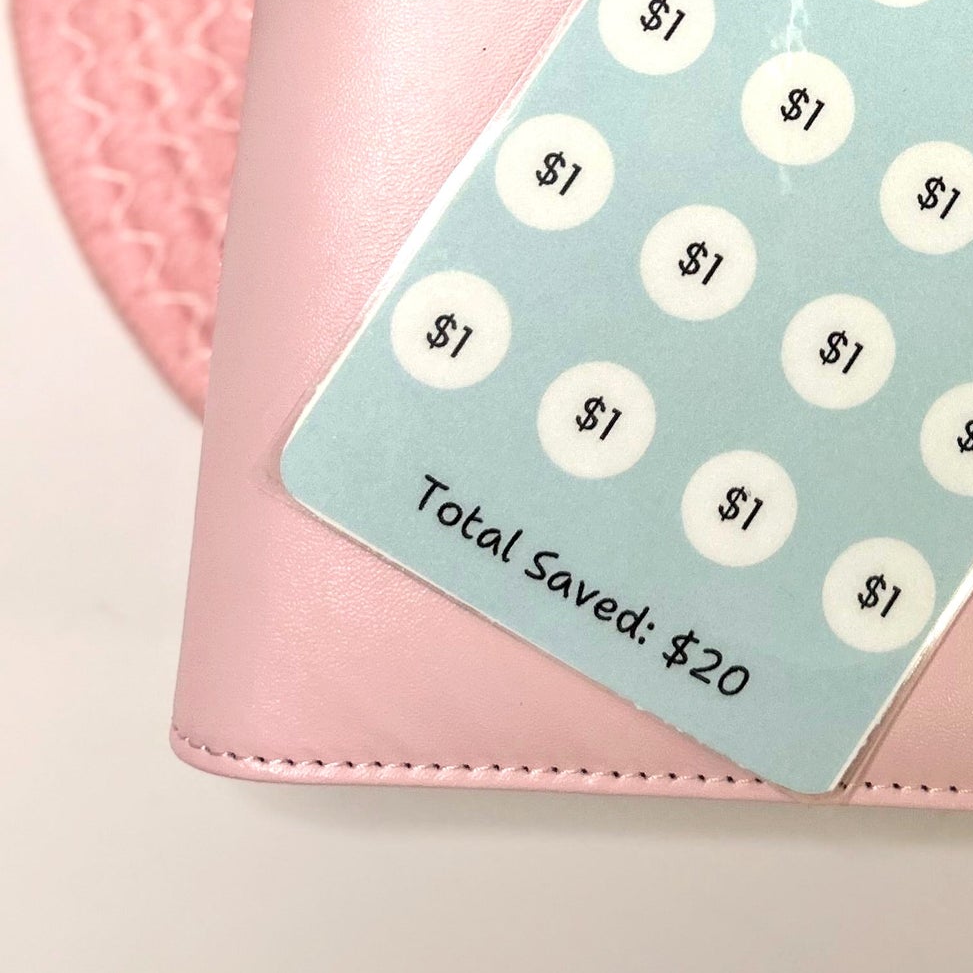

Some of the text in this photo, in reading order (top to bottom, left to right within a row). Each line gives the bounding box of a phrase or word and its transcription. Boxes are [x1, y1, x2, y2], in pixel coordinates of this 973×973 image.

[780, 87, 825, 132] $1
[535, 151, 582, 196] $1
[916, 175, 961, 220] $1
[678, 241, 724, 286] $1
[426, 313, 474, 359] $1
[819, 330, 864, 375] $1
[575, 395, 623, 441] $1
[718, 486, 764, 531] $1
[418, 473, 750, 697] Total Saved: $20
[857, 573, 902, 619] $1
